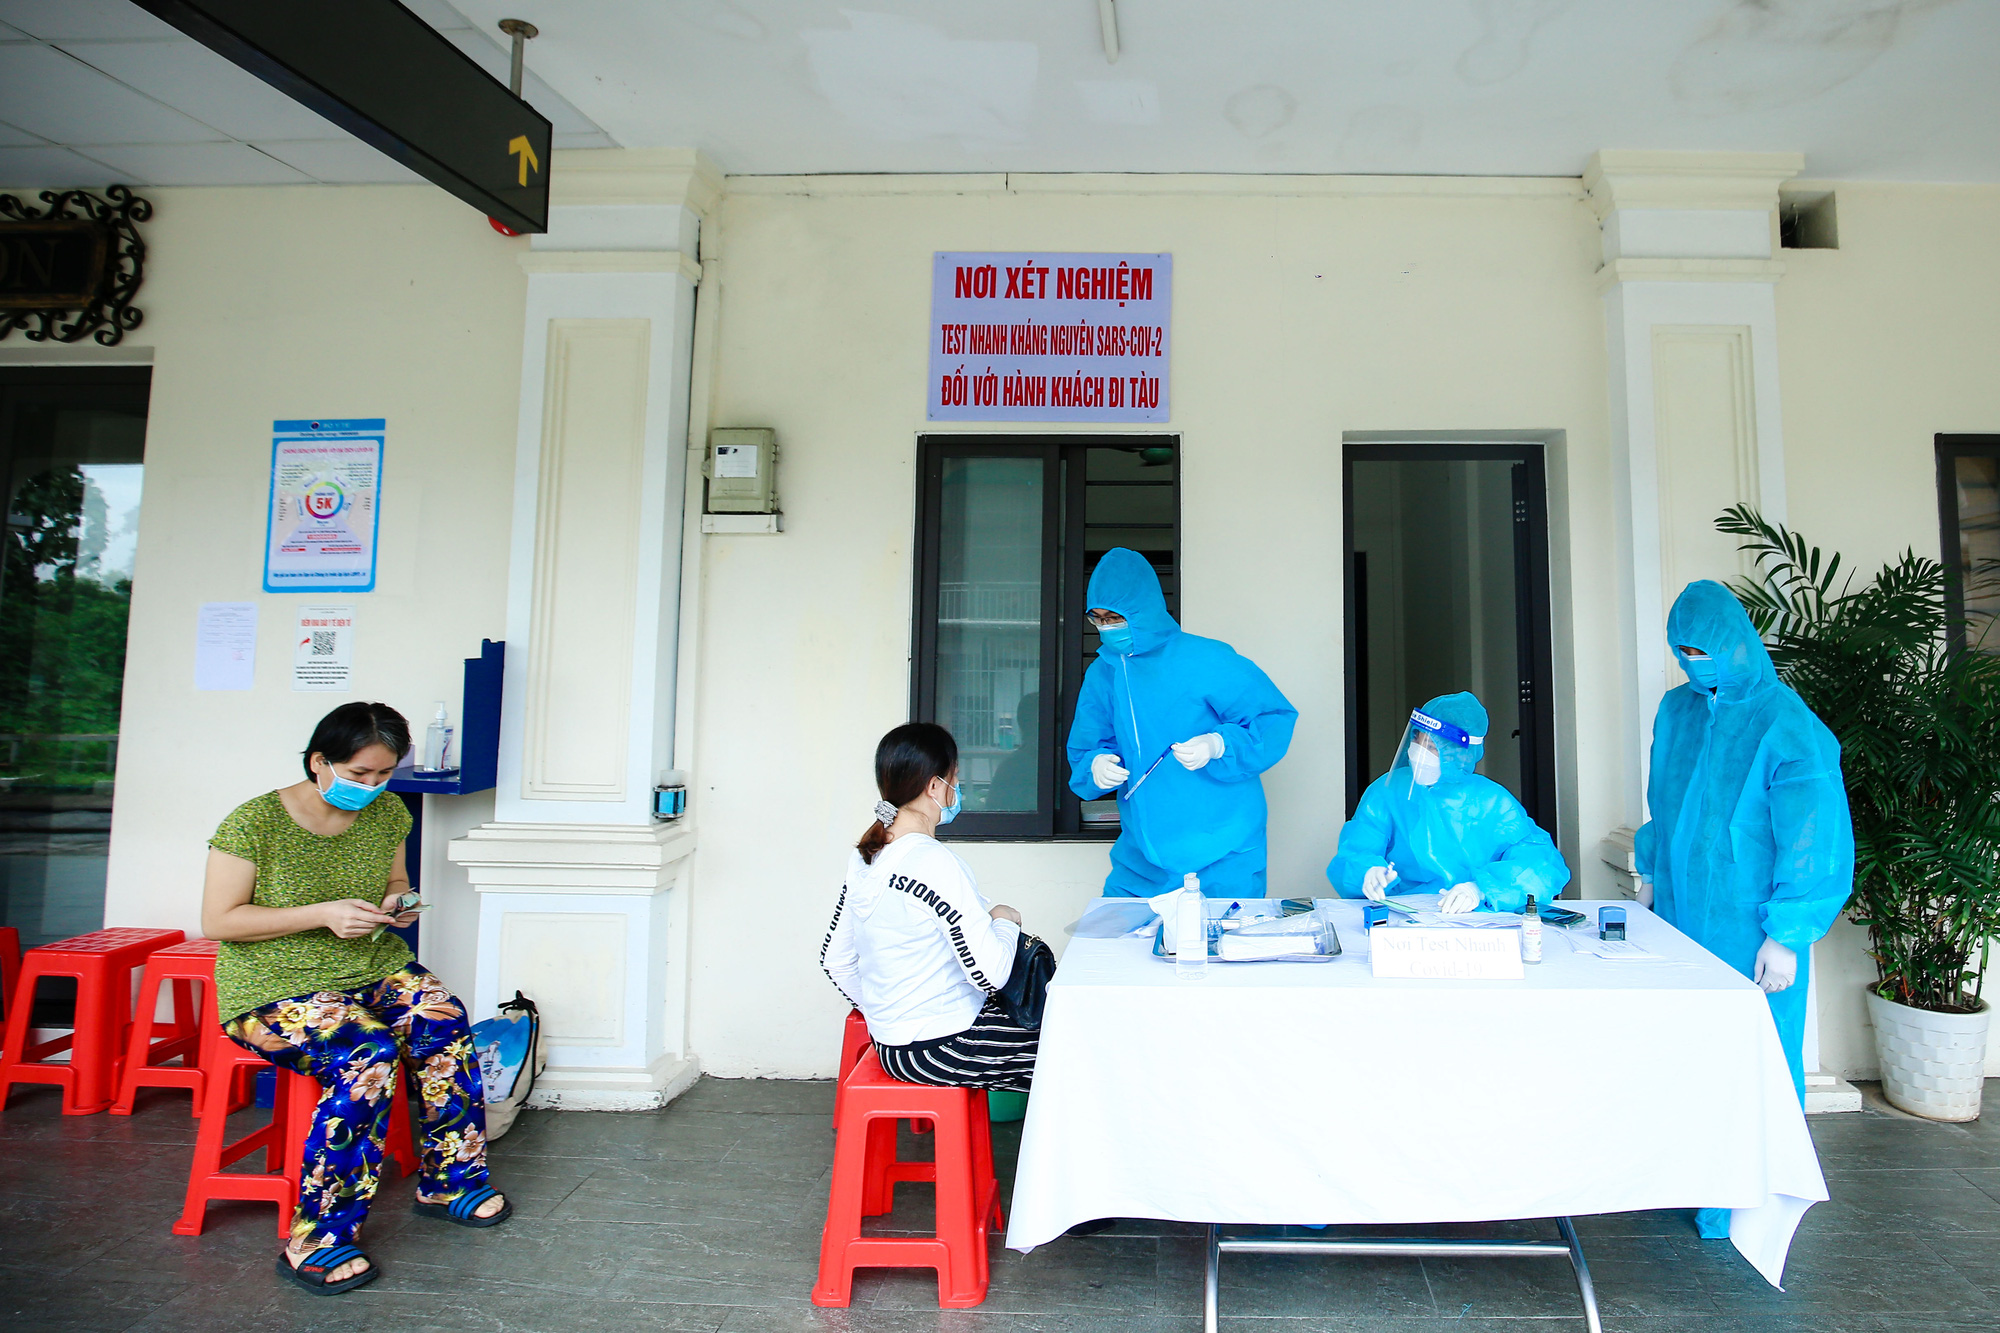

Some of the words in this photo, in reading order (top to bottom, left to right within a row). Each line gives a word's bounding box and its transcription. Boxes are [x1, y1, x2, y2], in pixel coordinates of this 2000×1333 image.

[955, 264, 997, 299] NƠI
[1004, 260, 1049, 299] XÉT
[1056, 261, 1153, 307] NGHIỆM
[942, 324, 968, 354] TEST
[969, 324, 1008, 355] NHANH
[1010, 318, 1047, 356] KHÁNG
[1050, 319, 1094, 356] NGUYÊN
[1096, 325, 1163, 357] SARS-COV-2
[941, 364, 969, 406] ĐỐI
[973, 366, 999, 406] VỚI
[1003, 370, 1046, 407] HÀNH
[1051, 370, 1104, 408] KHÁCH
[1108, 376, 1125, 408] ĐI
[1129, 371, 1160, 409] TÀU
[315, 497, 333, 510] 5K
[1416, 714, 1439, 728] Shield
[949, 925, 977, 969] MIND
[1416, 936, 1450, 952] Test
[1454, 937, 1507, 953] Nhanh
[1409, 960, 1483, 977] Covid-19
